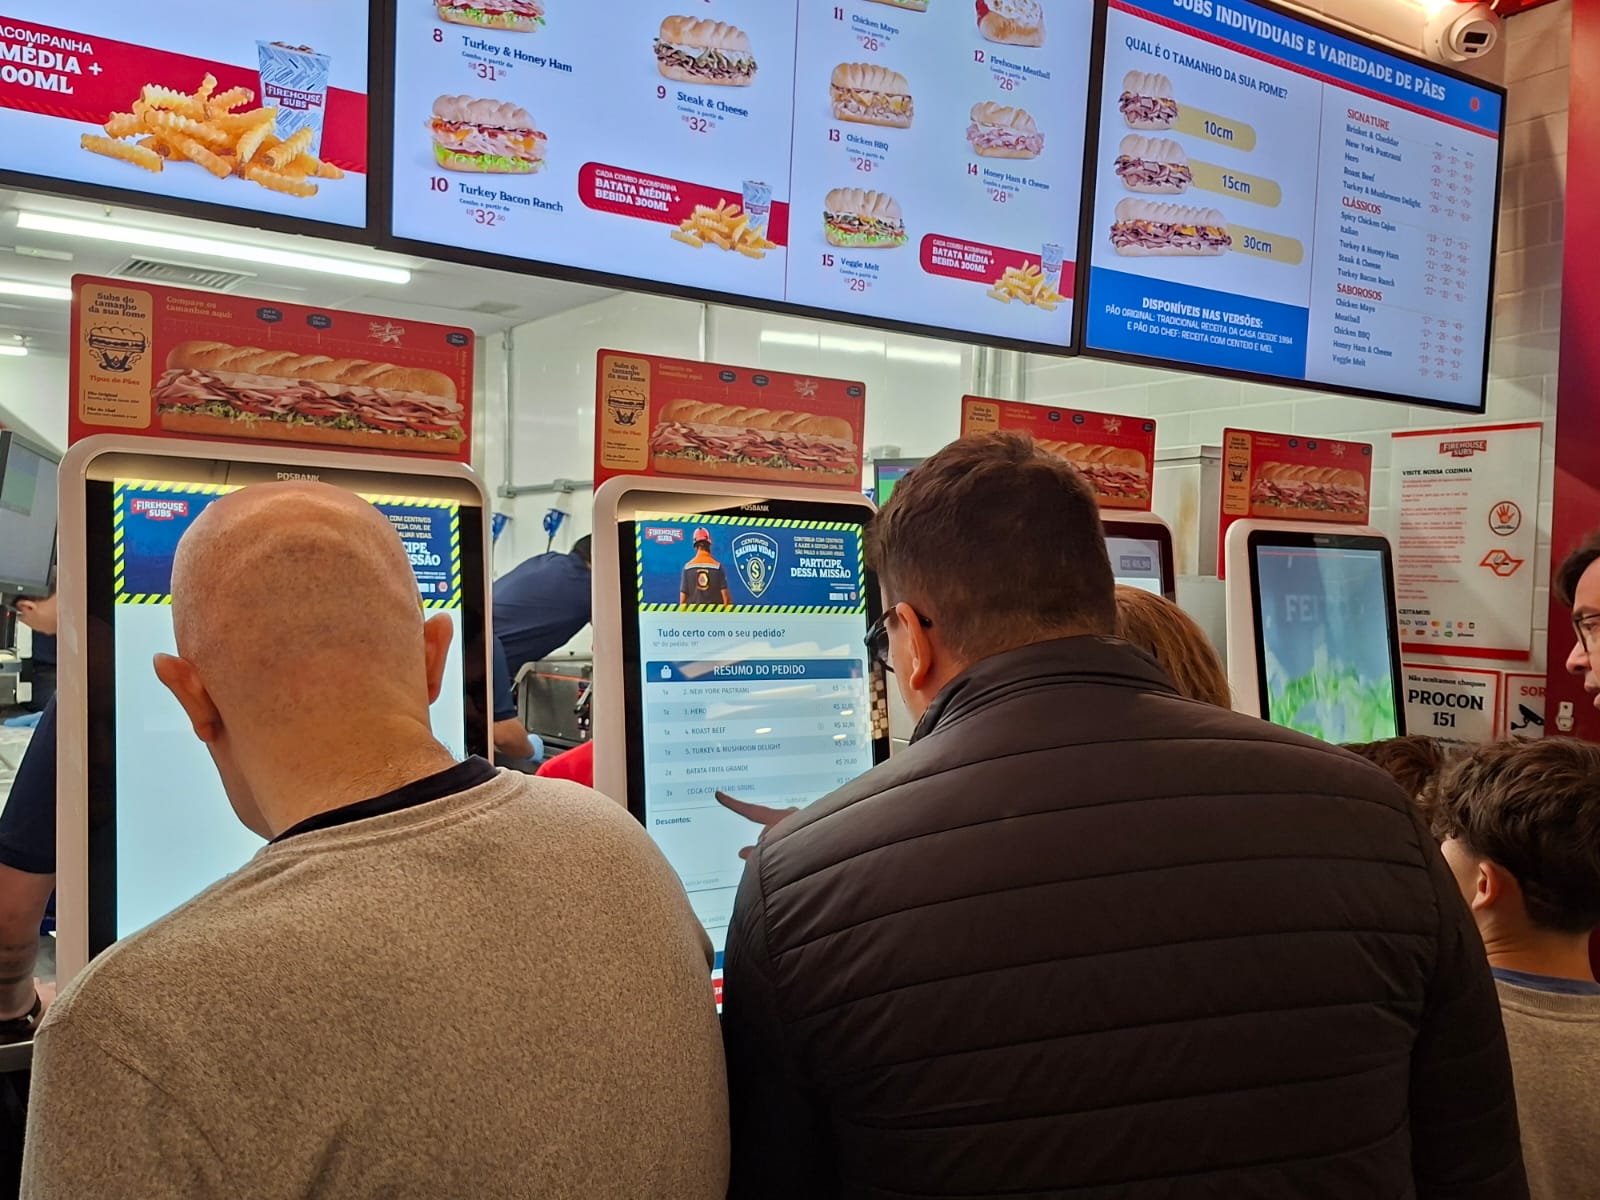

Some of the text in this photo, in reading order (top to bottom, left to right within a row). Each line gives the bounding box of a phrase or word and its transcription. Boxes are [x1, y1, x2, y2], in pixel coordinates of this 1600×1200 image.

[834, 7, 843, 21] 11
[852, 14, 899, 34] Chicken Mayo
[433, 28, 443, 42] 8
[864, 37, 878, 51] 26
[0, 41, 103, 75] MÉDIA +
[462, 36, 572, 73] Turkey & Honey Ham
[974, 50, 984, 63] 12
[1216, 5, 1304, 52] INDIVIDUAIS
[1308, 38, 1315, 56] E
[1320, 43, 1392, 83] VARIEDADE
[1396, 71, 1412, 89] DE
[1415, 77, 1446, 101] PÃES
[477, 63, 496, 81] 31
[991, 56, 1050, 79] Firehouse Meatball
[1125, 36, 1288, 99] QUAL É O TAMANHO DA SUA FOME?
[0, 65, 73, 94] 00ML
[1000, 77, 1013, 91] 26
[267, 85, 322, 105] FIREHOUSE
[657, 86, 666, 99] 9
[283, 98, 308, 109] SUBS
[677, 92, 748, 117] Steak & Cheese
[690, 117, 706, 133] 32
[1348, 109, 1390, 130] SIGNATURE
[829, 129, 840, 142] 13
[1204, 120, 1233, 140] 10cm
[1346, 124, 1368, 137] Brisket
[1376, 133, 1399, 146] Cheddar
[847, 134, 888, 151] Chicken BBQ
[856, 158, 871, 171] 28
[968, 163, 977, 175] 14
[430, 177, 448, 192] 10
[596, 169, 677, 192] CADA COMBO ACOMPANHA
[984, 168, 1004, 181] Honey
[1006, 174, 1020, 183] Ham
[1028, 179, 1049, 189] Cheese
[1222, 175, 1250, 193] 15cm
[459, 183, 563, 212] Turkey Bacon Ranch
[595, 178, 636, 195] BATATA
[639, 187, 672, 202] MÉDIA
[993, 190, 1006, 203] 28
[595, 189, 669, 212] BEBIDA 300ML
[1343, 196, 1381, 215] CLÁSSICOS
[475, 209, 496, 226] 32
[1341, 226, 1358, 236] Italian
[1243, 235, 1272, 253] 30cm
[822, 254, 833, 266] 15
[933, 247, 988, 264] BATATA MÉDIA
[841, 257, 879, 271] Veggie Melt
[932, 256, 986, 273] BEBIDA 300ML
[850, 279, 865, 292] 29
[1337, 283, 1382, 300] SABOROSOS
[97, 293, 120, 301] Subs
[95, 300, 136, 310] tamanho
[1336, 298, 1375, 313] Chicken Mayo
[122, 309, 145, 319] fome
[1142, 297, 1263, 329] DISPONÍVEIS NAS VERSÕES:
[1335, 312, 1360, 323] Meatball
[1106, 304, 1120, 316] PÃO
[1122, 308, 1155, 322] ORIGINAL:
[1157, 314, 1199, 329] TRADICIONAL
[1201, 322, 1227, 334] RECEITA
[1229, 327, 1237, 336] DA
[1239, 329, 1256, 338] CASA
[1258, 332, 1277, 343] DESDE
[1127, 322, 1132, 330] E
[1133, 322, 1147, 333] PÃO
[1149, 326, 1159, 335] DO
[1161, 327, 1180, 338] CHEF:
[1181, 331, 1208, 343] RECEITA
[1210, 335, 1225, 345] COM
[1227, 337, 1253, 350] CENTEIO
[1260, 344, 1273, 353] MEL
[1444, 442, 1484, 450] FIREHOUSE
[277, 472, 320, 482] POSBANK
[137, 501, 184, 512] FIREHOUSE
[649, 529, 681, 538] FIREHOUSE
[736, 544, 775, 559] SALVAM VIDAS
[800, 558, 842, 568] PARTICIPE
[791, 568, 851, 578] DESSA MISSÃO
[658, 629, 679, 637] Tudo
[683, 629, 705, 637] certo
[753, 629, 785, 639] pedido?
[714, 665, 805, 676] RESUMO DO PEDIDO
[1422, 677, 1456, 685] aceitamos
[1458, 679, 1486, 687] cheques
[1521, 686, 1545, 696] SOR
[1408, 689, 1484, 710] PROCON
[1433, 712, 1455, 727] 151
[656, 817, 691, 825] Descontos:
